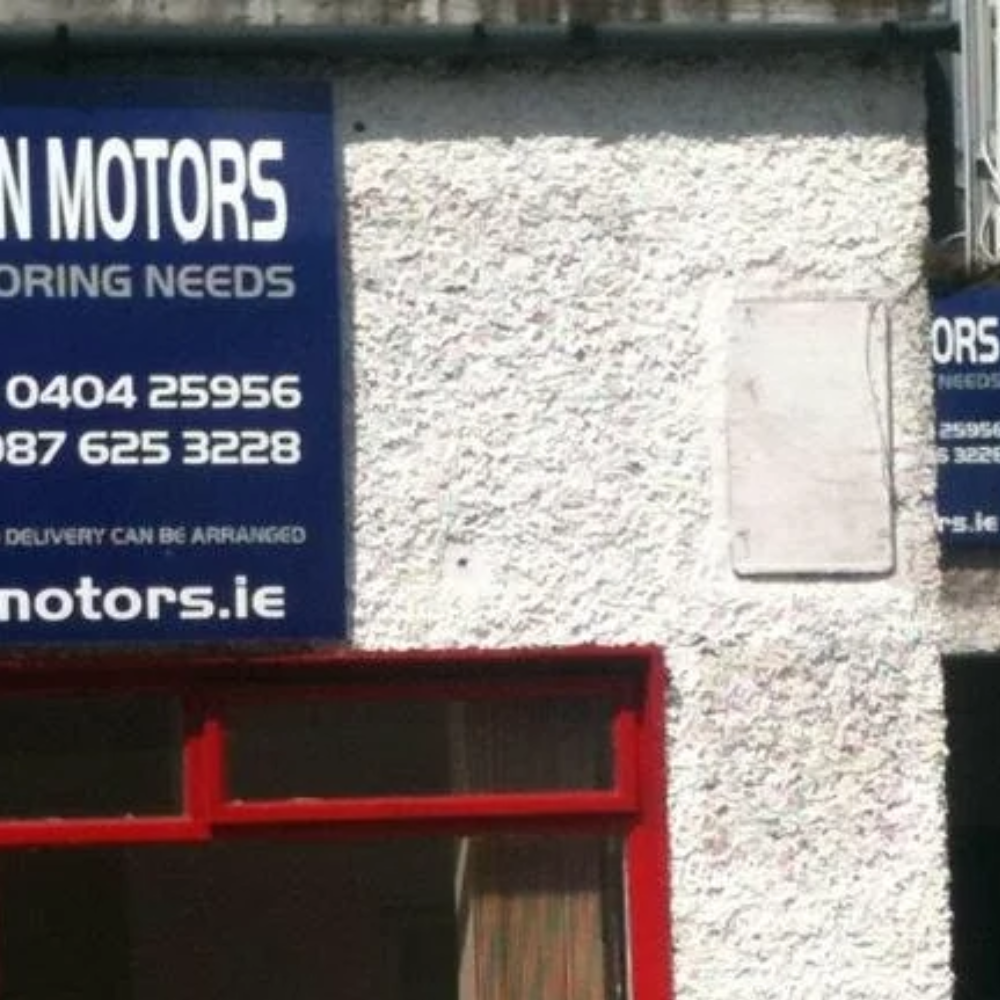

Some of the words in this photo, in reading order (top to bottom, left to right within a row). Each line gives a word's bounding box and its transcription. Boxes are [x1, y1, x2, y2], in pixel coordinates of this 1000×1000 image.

[47, 137, 288, 242] MOTORS
[145, 264, 295, 298] NEEDS
[931, 316, 1000, 364] ORS
[5, 373, 138, 410] 0404
[147, 373, 303, 410] 25956
[77, 429, 172, 466] 625
[181, 429, 302, 465] 3228
[5, 527, 106, 546] DELIVERY
[110, 527, 154, 545] CAN
[158, 526, 186, 545] BE
[190, 525, 307, 545] ARRANGED
